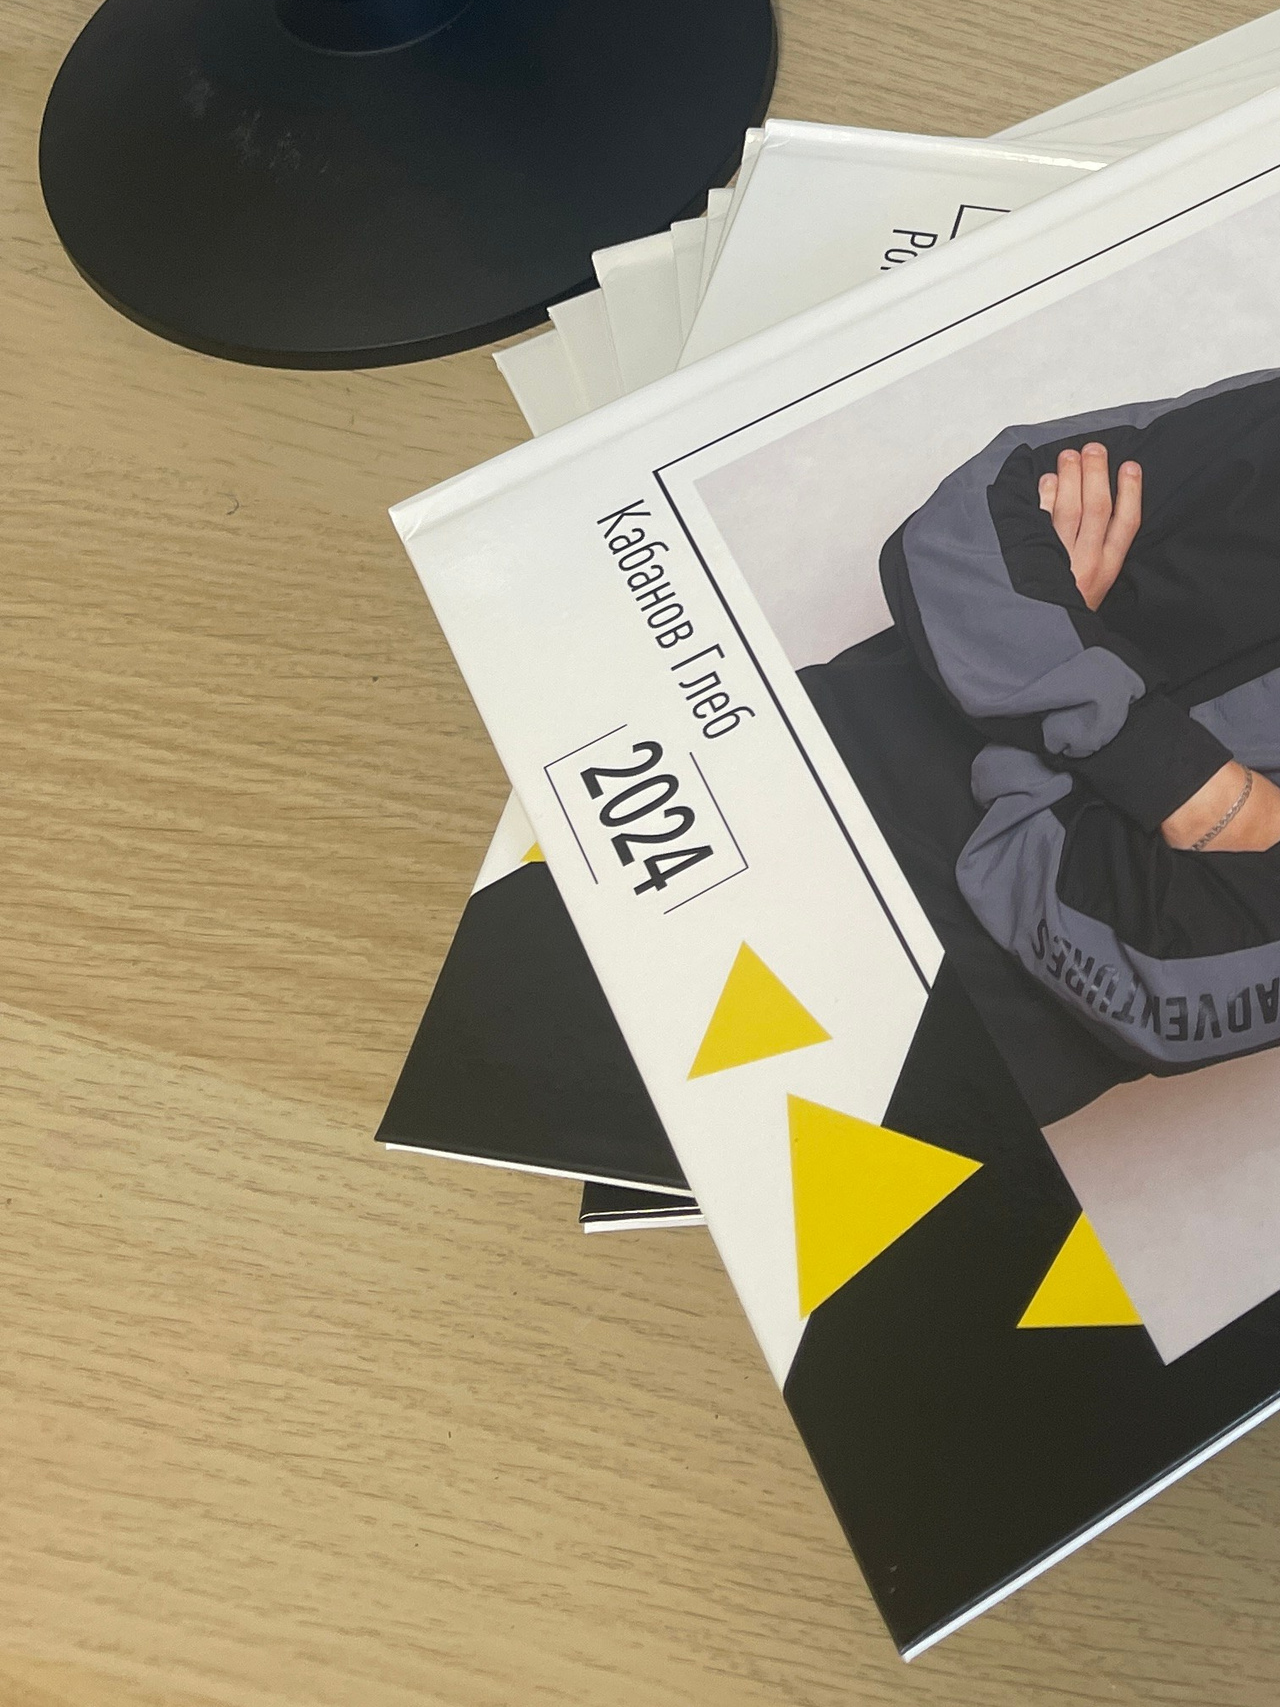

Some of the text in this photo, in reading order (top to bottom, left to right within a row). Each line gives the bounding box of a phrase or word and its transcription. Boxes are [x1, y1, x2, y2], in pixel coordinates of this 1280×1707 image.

[596, 498, 756, 740] Кабанов Глеб
[579, 740, 715, 897] 2024
[1032, 916, 1280, 1042] ADVENTURES
